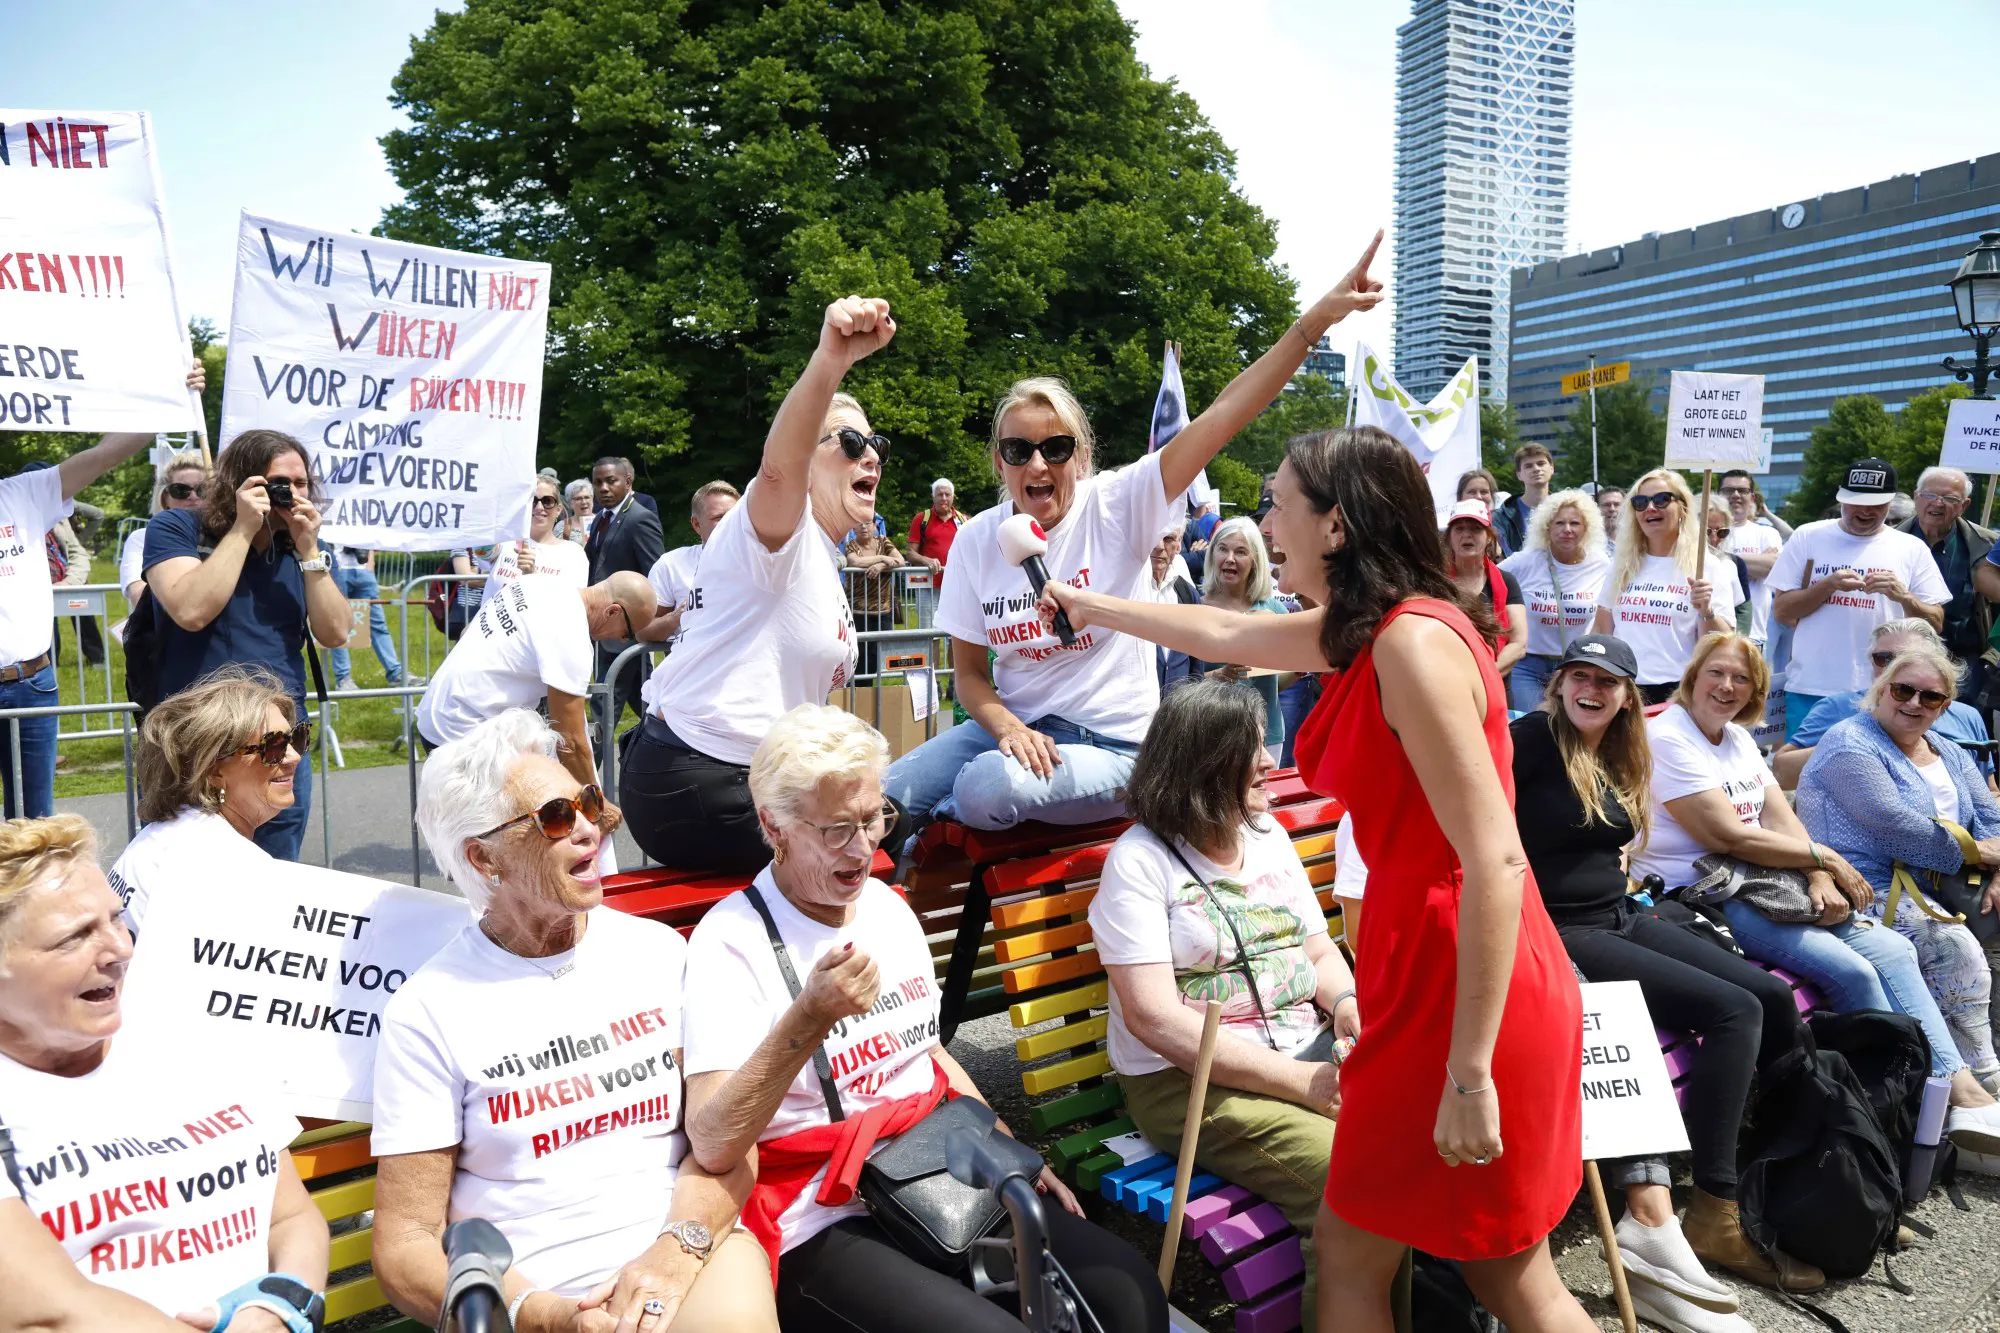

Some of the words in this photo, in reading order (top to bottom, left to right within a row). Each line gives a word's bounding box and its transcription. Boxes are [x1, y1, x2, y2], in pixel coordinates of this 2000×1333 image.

[253, 355, 346, 408] VOOR
[358, 374, 395, 412] DE
[1694, 389, 1719, 401] LAAT
[1721, 390, 1741, 401] HET
[1684, 408, 1719, 419] GROTE
[1721, 409, 1747, 420] GELD
[1682, 427, 1706, 438] NIET
[1708, 428, 1746, 439] WINNEN
[1970, 441, 1987, 450] DE
[1851, 471, 1883, 486] OBEY
[10, 544, 25, 557] de
[1815, 564, 1830, 576] wij
[686, 587, 704, 611] DE
[1534, 590, 1548, 601] wij
[1626, 583, 1634, 594] ij
[1634, 582, 1665, 593] willen
[982, 596, 1005, 619] wij
[1531, 602, 1559, 614] WIJKE
[1565, 606, 1587, 614] voor
[1649, 599, 1674, 609] voor
[1676, 601, 1689, 613] de
[1621, 611, 1672, 626] RIJKEN!!!!!
[986, 620, 1042, 646] WIJKEN
[292, 904, 371, 940] NIET
[193, 937, 328, 981] WIJKEN
[340, 960, 410, 994] VOO
[206, 990, 258, 1021] DE
[481, 1053, 526, 1079] wij
[527, 1033, 610, 1071] willen
[609, 1007, 667, 1046] NIET
[900, 1023, 926, 1049] voor
[487, 1073, 595, 1125] WIJKEN
[598, 1055, 657, 1093] voor
[532, 1093, 670, 1160] RIJKEN!!!!!
[26, 1141, 90, 1187] wij
[92, 1135, 189, 1163] willen
[183, 1103, 254, 1145] NIET
[177, 1158, 248, 1203] voor
[255, 1144, 278, 1178] de
[90, 1206, 257, 1275] RIJKEN!!!!!
